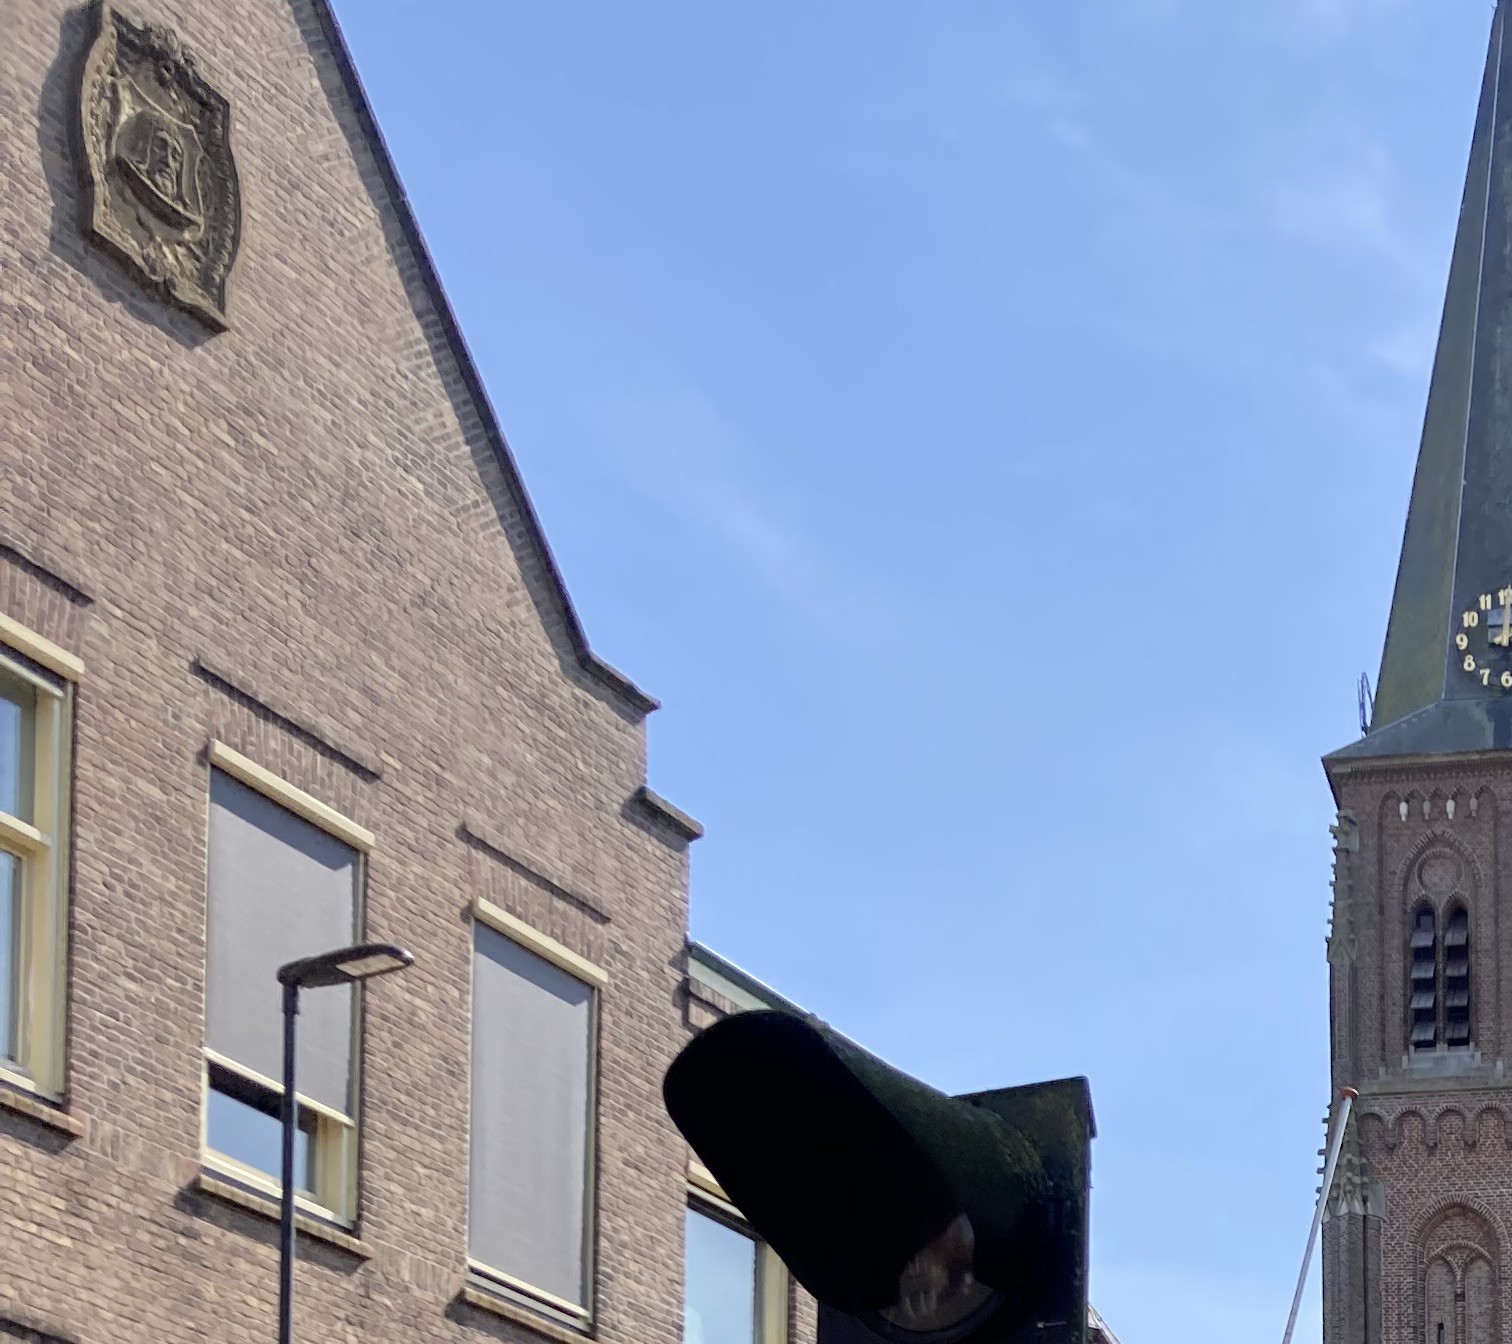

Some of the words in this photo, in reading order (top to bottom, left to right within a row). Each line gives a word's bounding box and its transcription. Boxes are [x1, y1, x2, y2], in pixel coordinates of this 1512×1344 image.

[1479, 593, 1492, 610] 11
[1462, 611, 1479, 628] 10
[1455, 633, 1468, 650] 9
[1463, 654, 1476, 672] 8
[1479, 668, 1491, 686] 7
